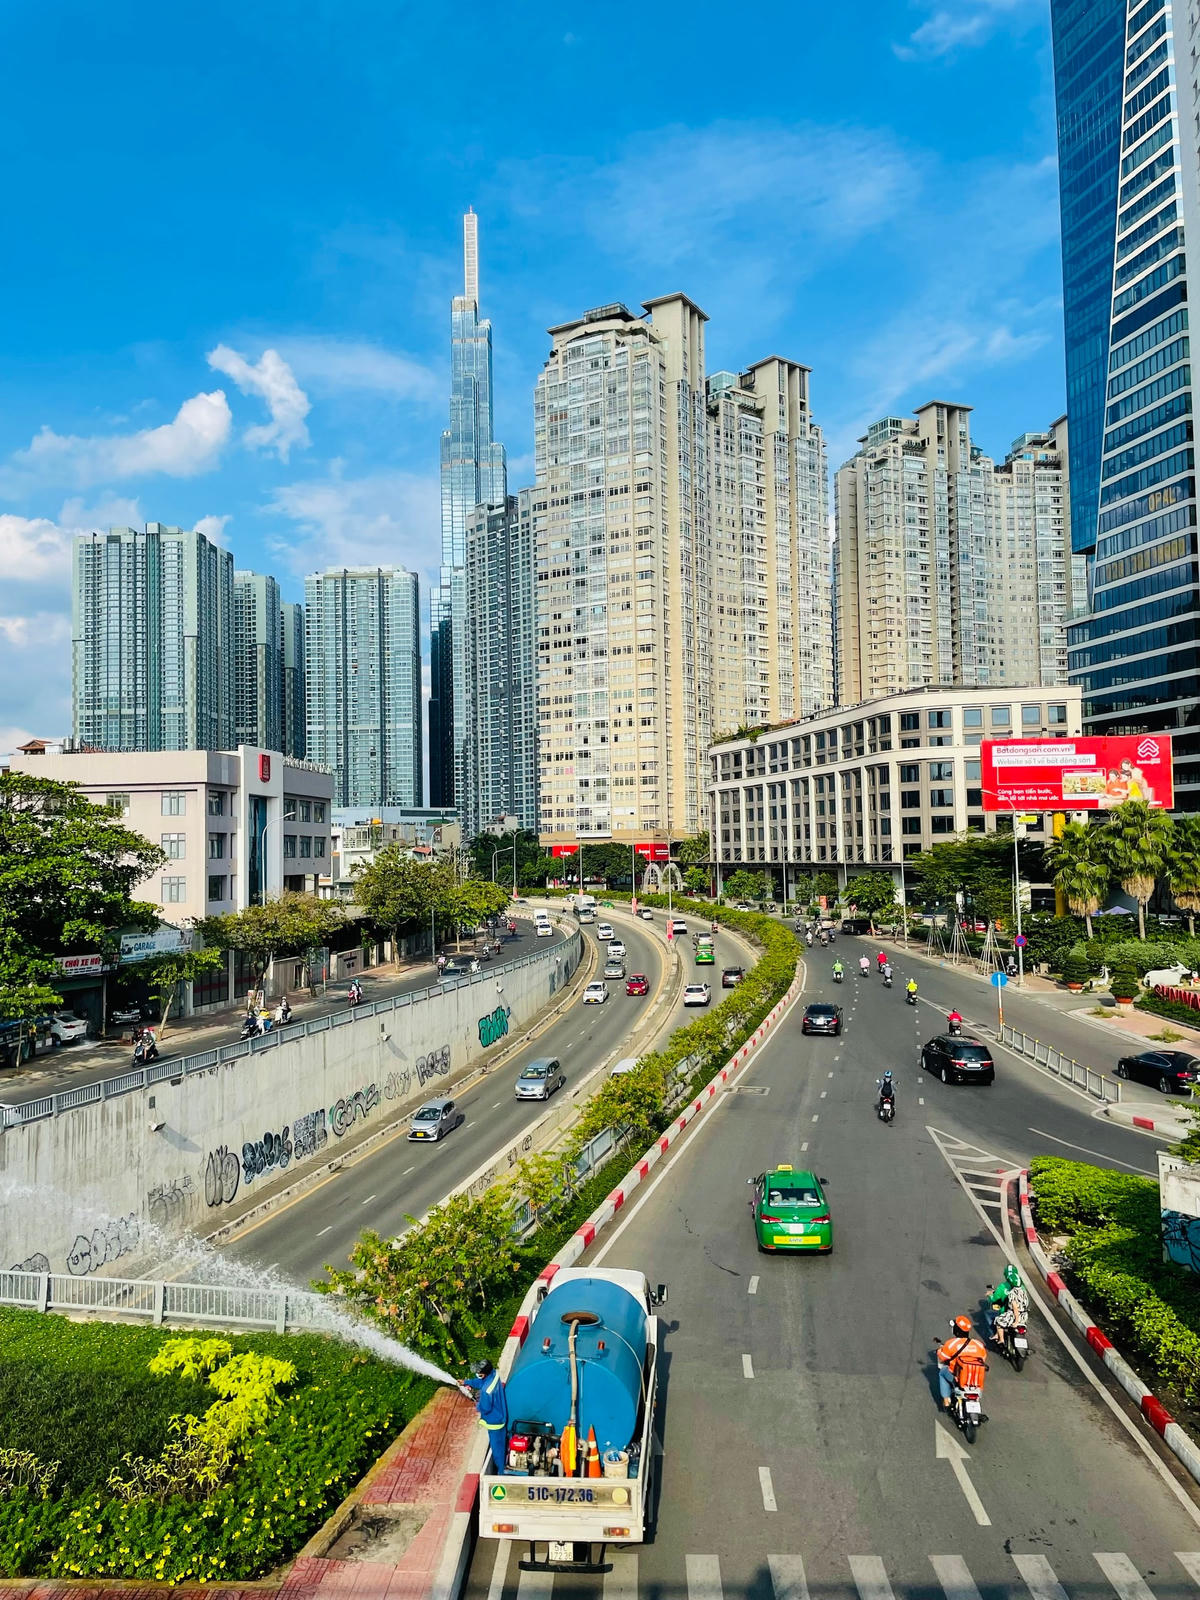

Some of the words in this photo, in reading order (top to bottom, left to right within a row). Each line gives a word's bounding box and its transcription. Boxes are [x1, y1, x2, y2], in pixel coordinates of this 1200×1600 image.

[134, 941, 156, 951] GARAGE
[81, 958, 89, 966] XE
[528, 1486, 593, 1503] 51C-172.36
